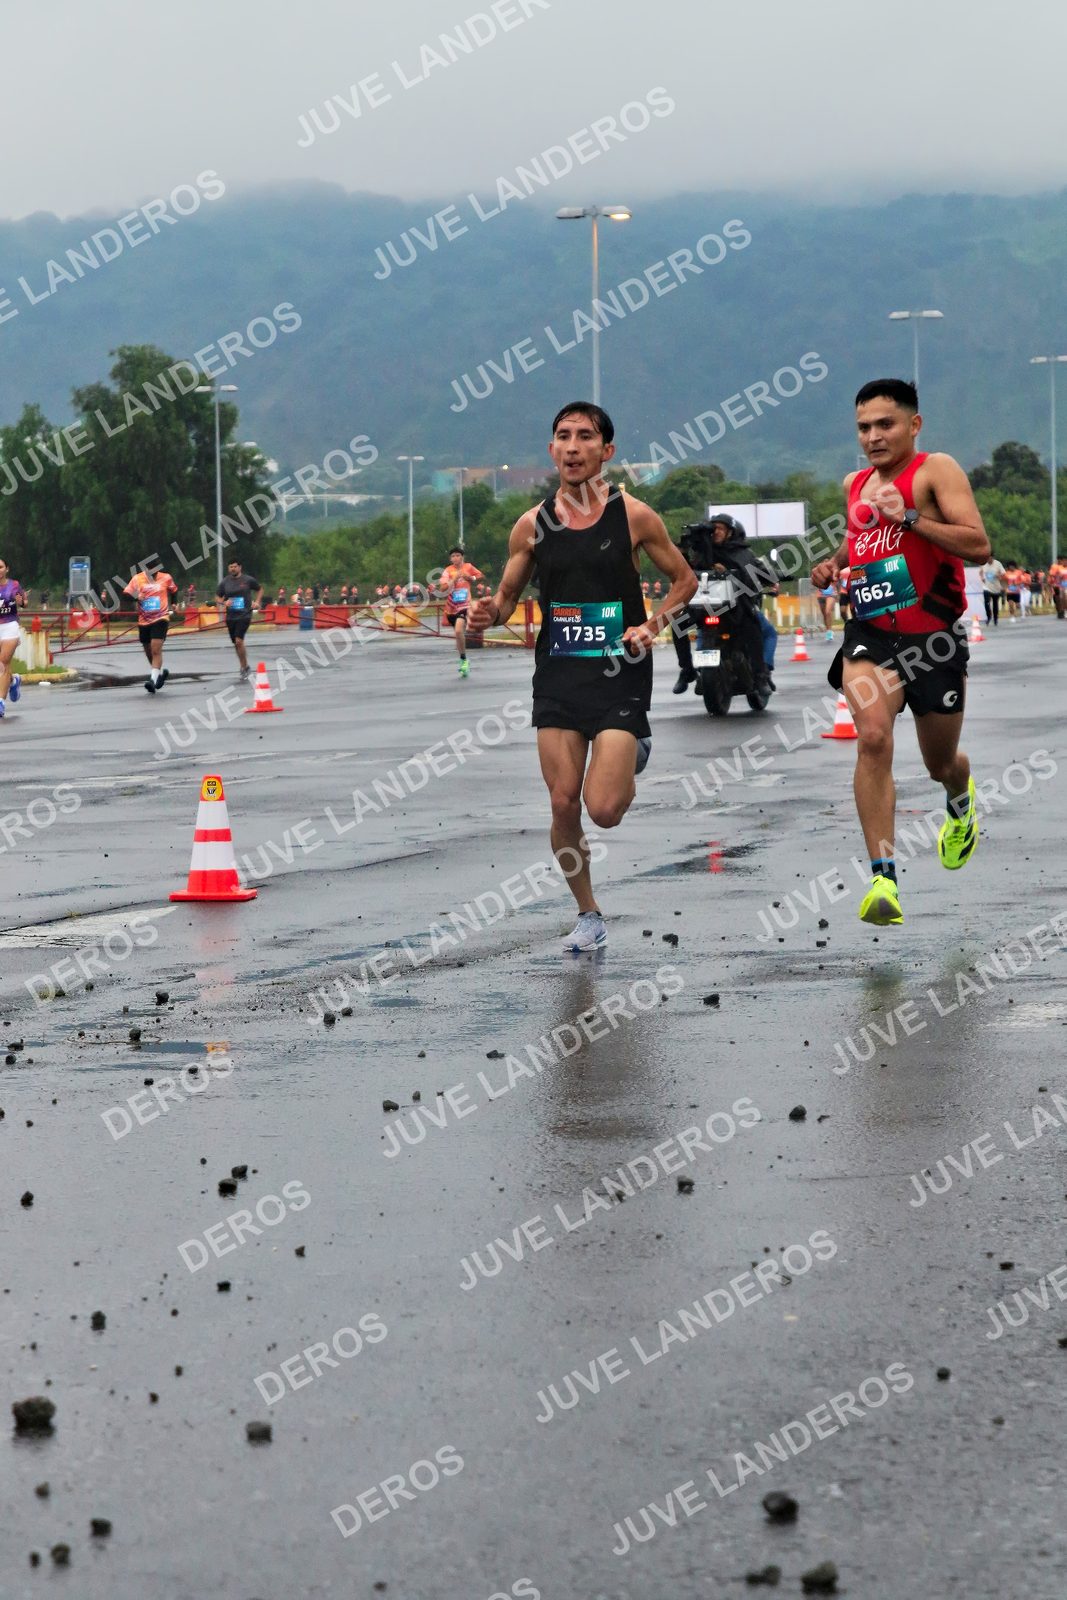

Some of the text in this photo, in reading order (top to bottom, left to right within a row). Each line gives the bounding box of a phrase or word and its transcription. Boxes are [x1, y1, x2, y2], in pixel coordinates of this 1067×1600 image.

[884, 560, 900, 572] 10K
[855, 582, 894, 604] 1662
[602, 606, 616, 618] 10K
[562, 626, 606, 642] 1735
